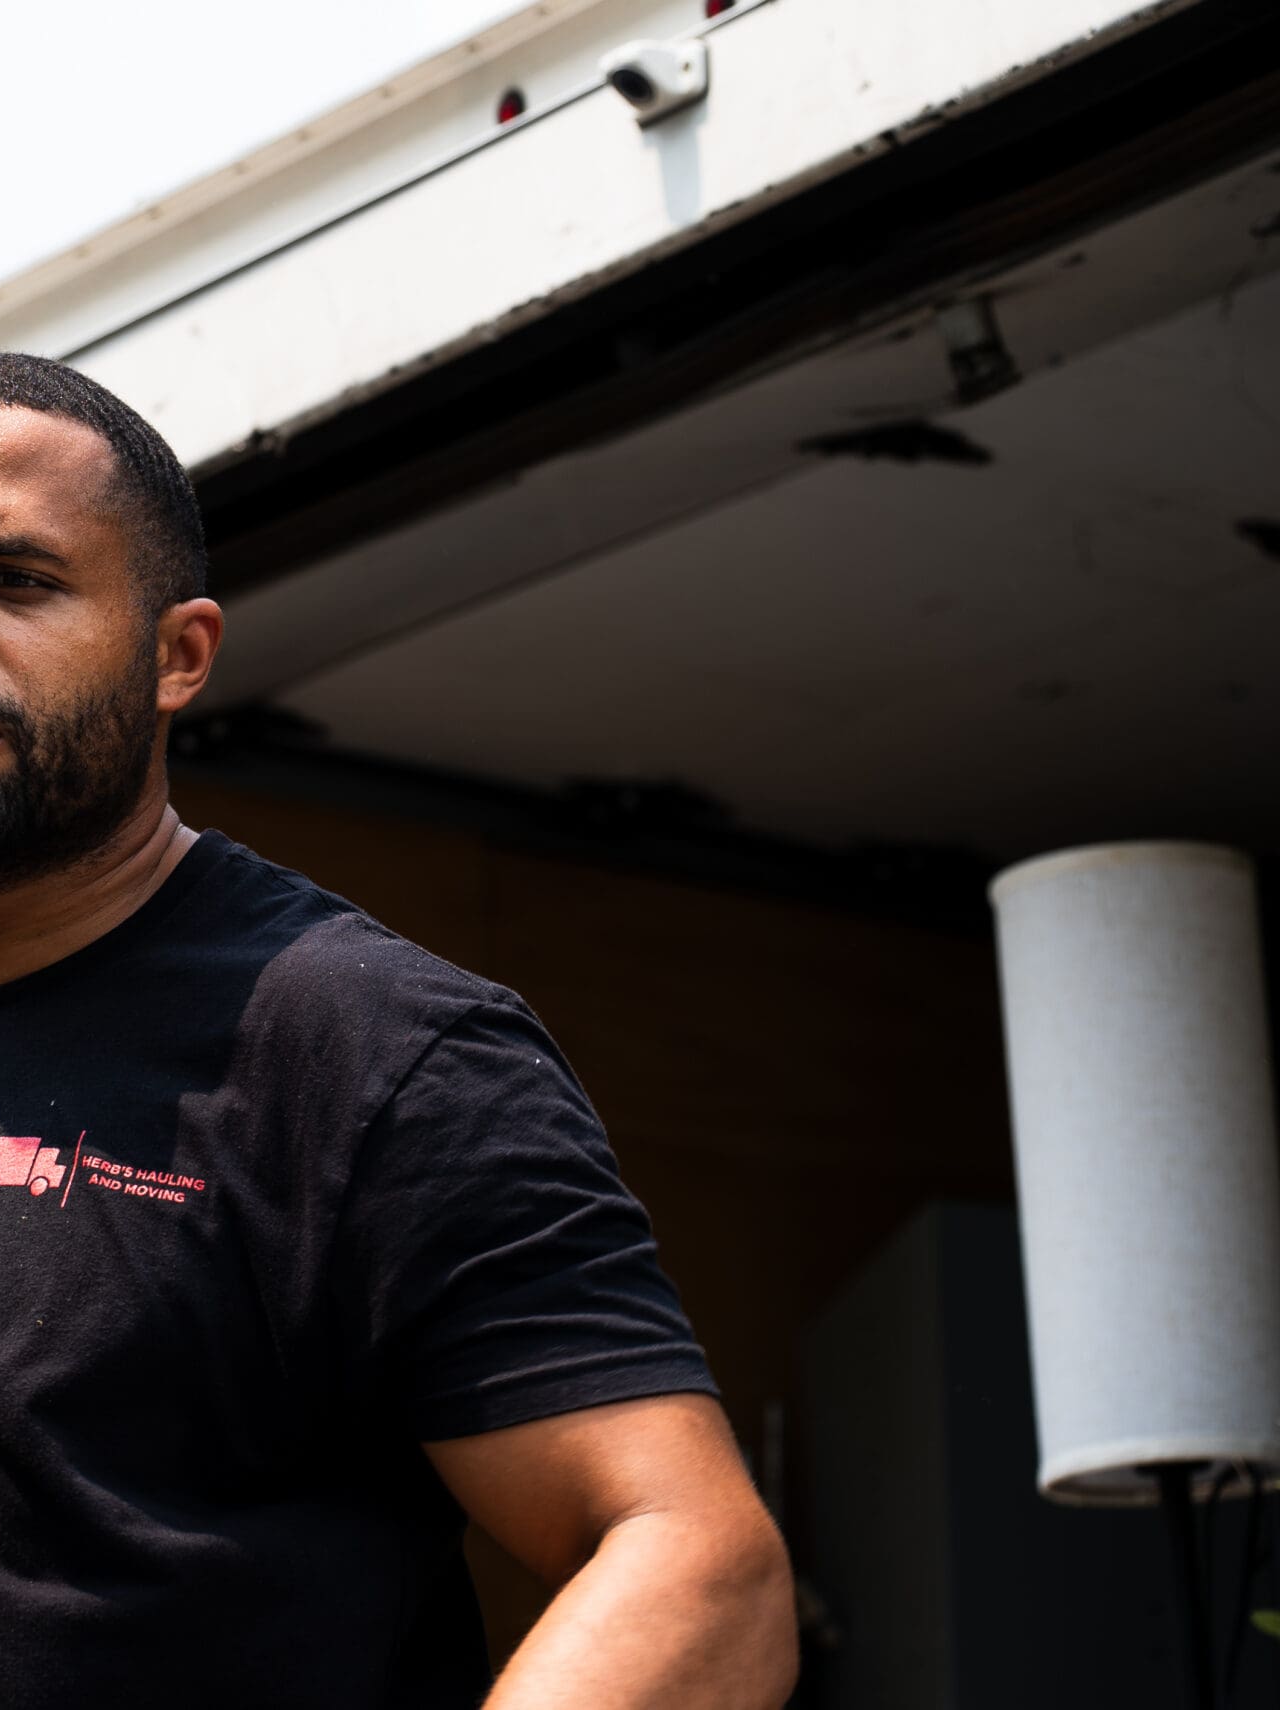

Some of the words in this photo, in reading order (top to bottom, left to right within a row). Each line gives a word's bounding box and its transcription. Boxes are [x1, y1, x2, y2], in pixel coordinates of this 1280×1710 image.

[81, 1155, 134, 1178] HERB'S
[135, 1169, 205, 1191] HAULING
[88, 1173, 122, 1191] AND
[124, 1183, 186, 1203] MOVING
